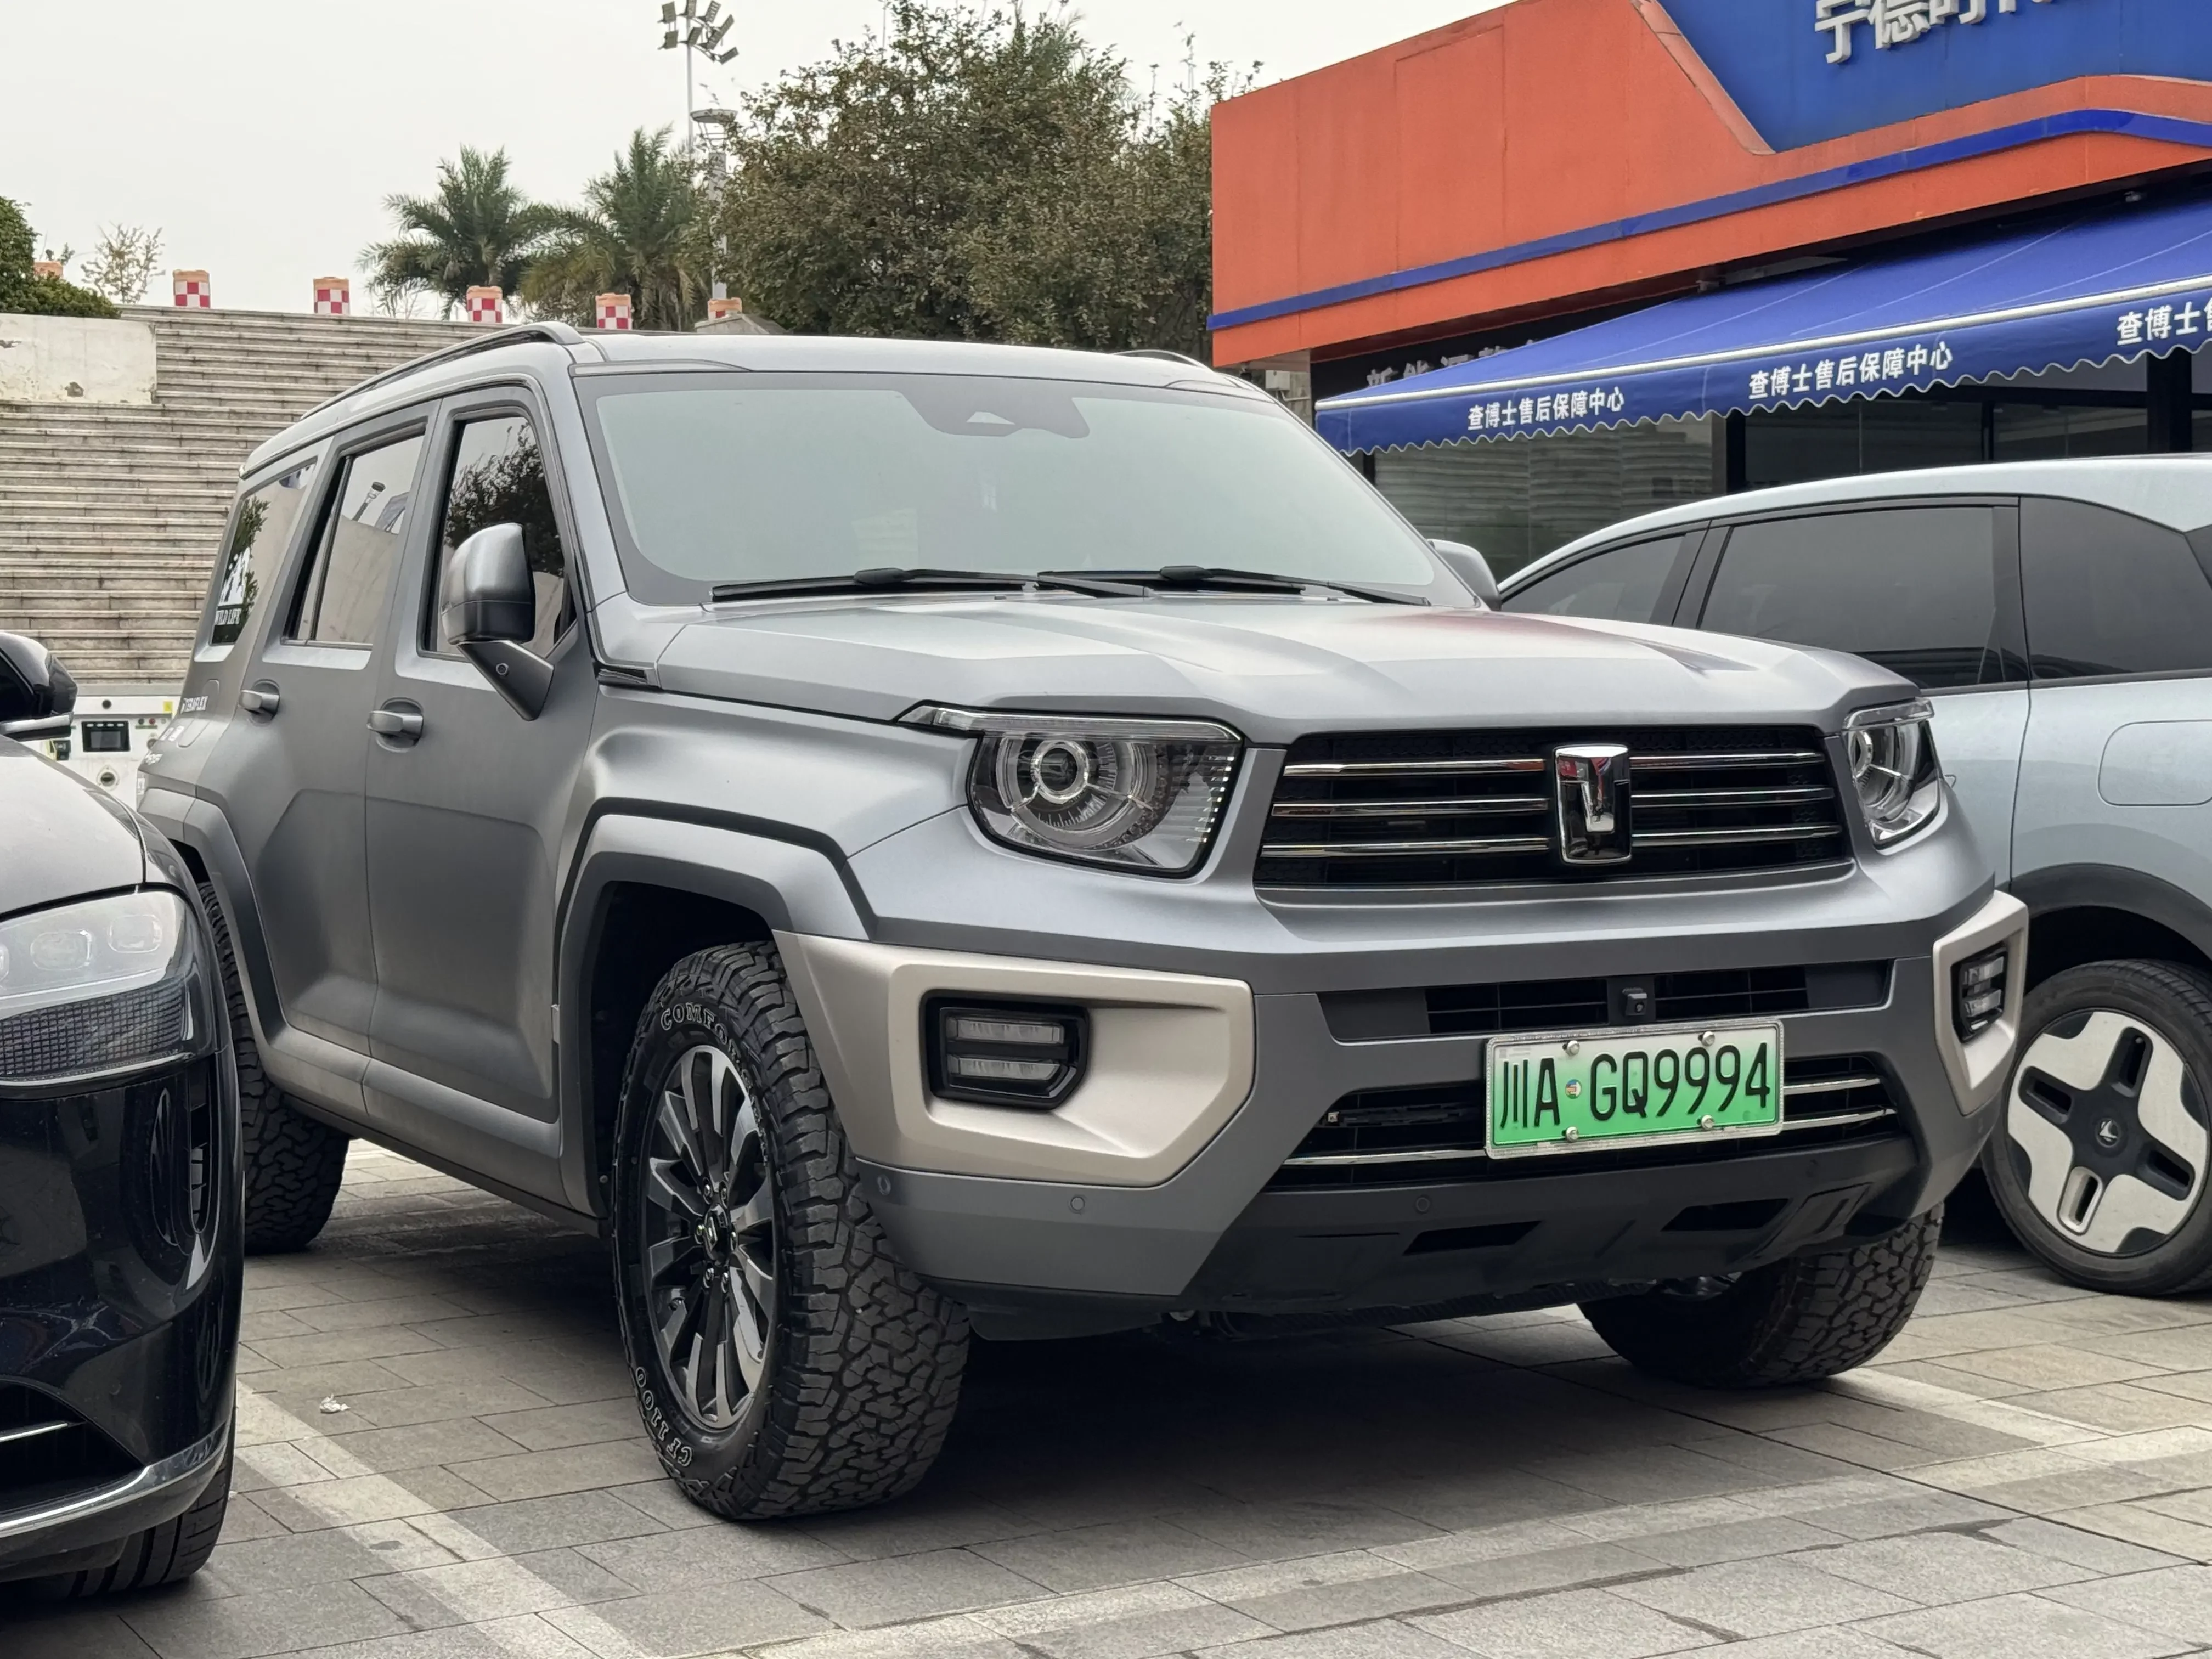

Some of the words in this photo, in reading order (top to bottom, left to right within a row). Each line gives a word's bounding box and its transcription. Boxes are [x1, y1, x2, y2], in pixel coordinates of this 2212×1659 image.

[1748, 340, 1953, 400] 查博士售后保障中心
[1468, 386, 1624, 430] 查博士售后保障中心
[1590, 1042, 1770, 1121] GQ9994
